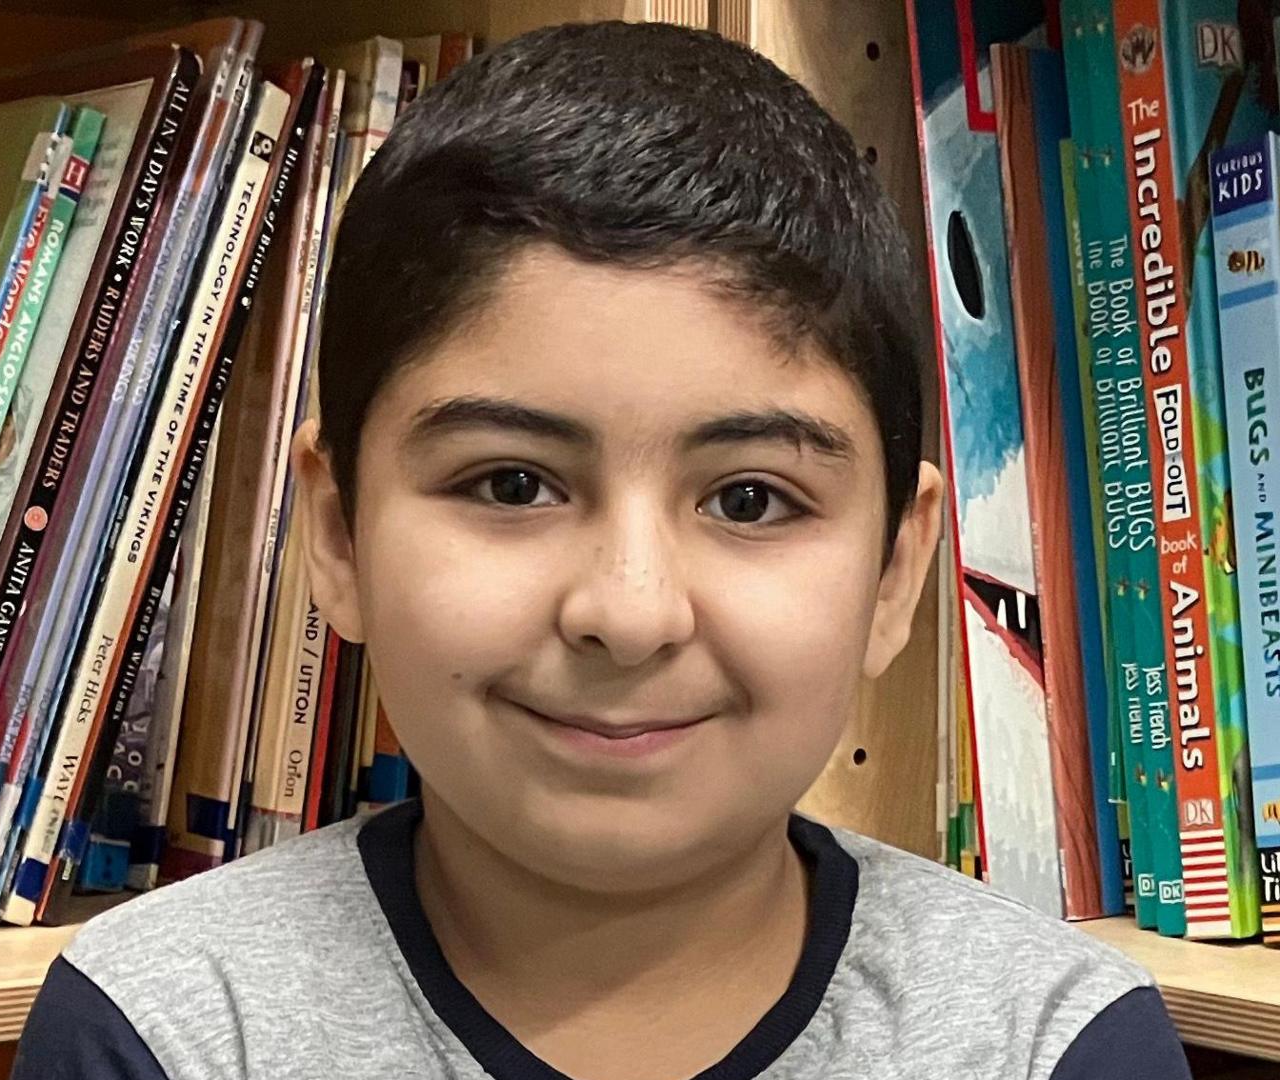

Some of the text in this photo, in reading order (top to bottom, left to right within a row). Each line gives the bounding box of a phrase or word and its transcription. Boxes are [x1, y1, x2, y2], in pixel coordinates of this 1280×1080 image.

[1127, 97, 1161, 126] The
[245, 147, 298, 290] History of Britain
[1218, 168, 1264, 203] KIDS
[40, 80, 191, 490] ALL IN A DAY'S WORK RAIDERS AND TRADERS
[1132, 127, 1176, 376] Incredible
[125, 178, 256, 564] TECHNOLOGY IN THE TIME OF THE VIKINGS
[1107, 234, 1155, 551] The Book of Brilliant BUGS
[1152, 388, 1191, 516] FOLD-OUT
[1243, 367, 1271, 466] BUGS
[1256, 472, 1266, 503] AND
[5, 541, 35, 597] ANITA
[1160, 530, 1199, 556] book
[1171, 555, 1188, 576] of
[134, 585, 161, 644] Brenda
[74, 633, 114, 725] Peter Hicks
[111, 650, 141, 722] Williams
[1141, 662, 1170, 749] Jess French
[1168, 579, 1211, 771] Animals
[282, 749, 304, 798] Orion
